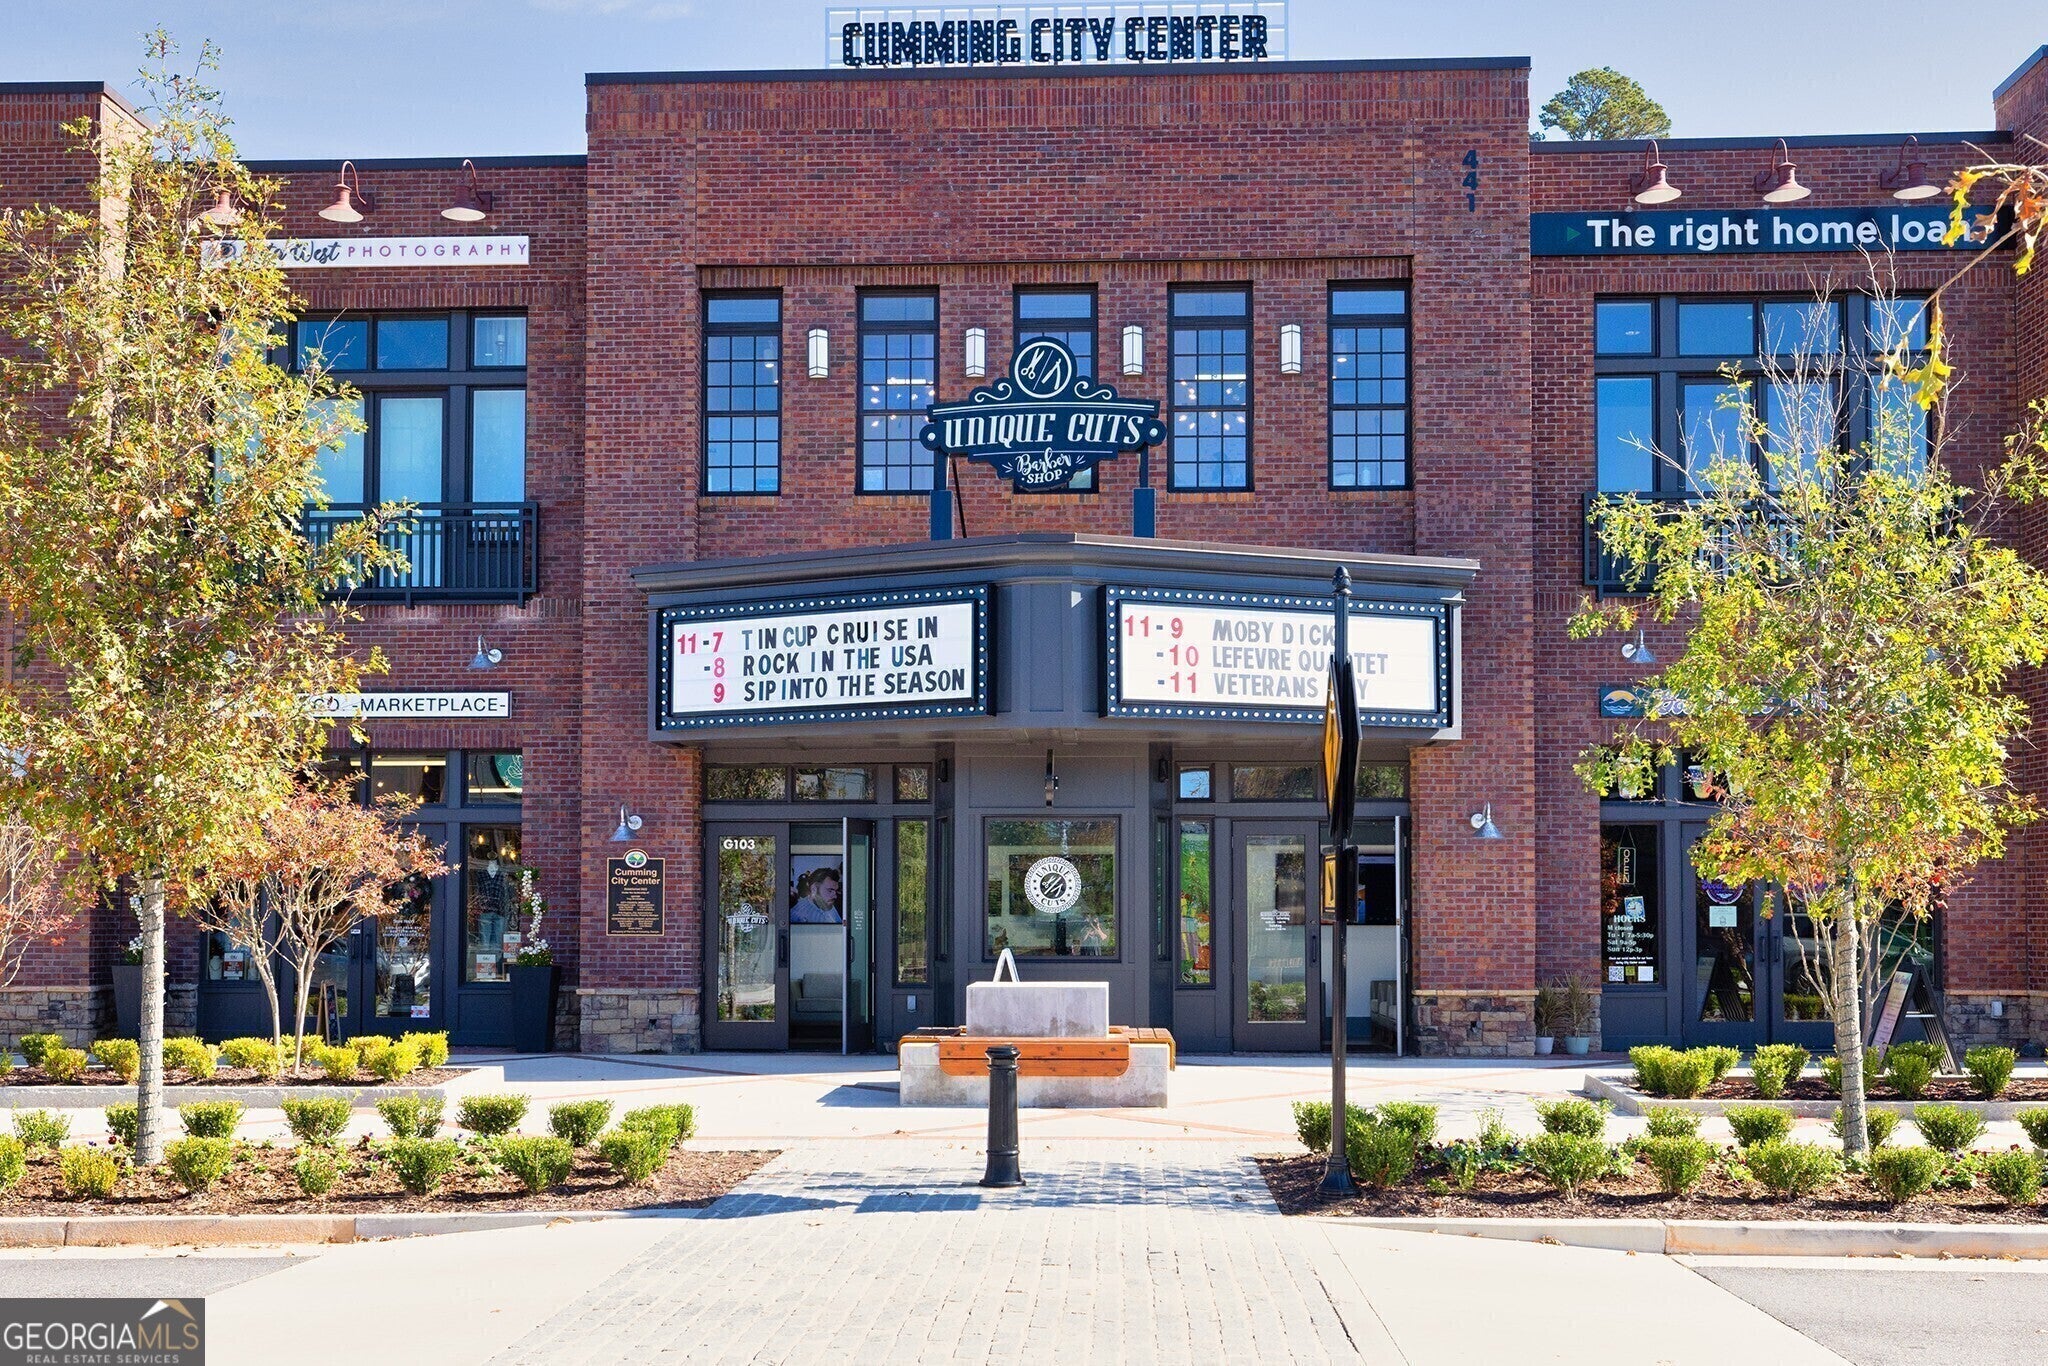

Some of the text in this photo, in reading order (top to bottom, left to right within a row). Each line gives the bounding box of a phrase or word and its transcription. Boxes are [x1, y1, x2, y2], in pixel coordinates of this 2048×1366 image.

[842, 14, 1268, 66] CUMMING CITY CENTER
[1462, 150, 1478, 212] 441
[1587, 219, 1656, 246] The
[1670, 217, 1758, 252] right
[1774, 215, 1877, 245] home
[348, 243, 526, 258] PHOTOGRAPHY
[943, 413, 1144, 448] UNIQUE CUTS
[1015, 447, 1072, 475] Barber
[1026, 471, 1063, 484] SHOP
[741, 628, 777, 650] TIN
[783, 625, 818, 648] CUP
[827, 618, 908, 645] CRUISE
[917, 616, 938, 639] IN
[1212, 619, 1274, 643] MOBY
[1282, 622, 1335, 646] DICK
[743, 652, 800, 676] ROCK
[810, 650, 834, 672] IN
[843, 647, 880, 671] THE
[891, 644, 933, 667] USA
[1212, 646, 1291, 671] LEFEVRE
[1298, 650, 1388, 675] QUTET
[713, 683, 725, 704] 9
[837, 674, 875, 697] THE
[883, 668, 965, 694] SEASON
[1214, 673, 1318, 698] VETERANS
[723, 839, 755, 850] G103
[611, 876, 660, 886] City Center
[615, 868, 657, 878] Cumming
[1036, 863, 1070, 878] UNIQUE
[1041, 898, 1066, 906] CUTS
[1613, 914, 1646, 923] HOURS
